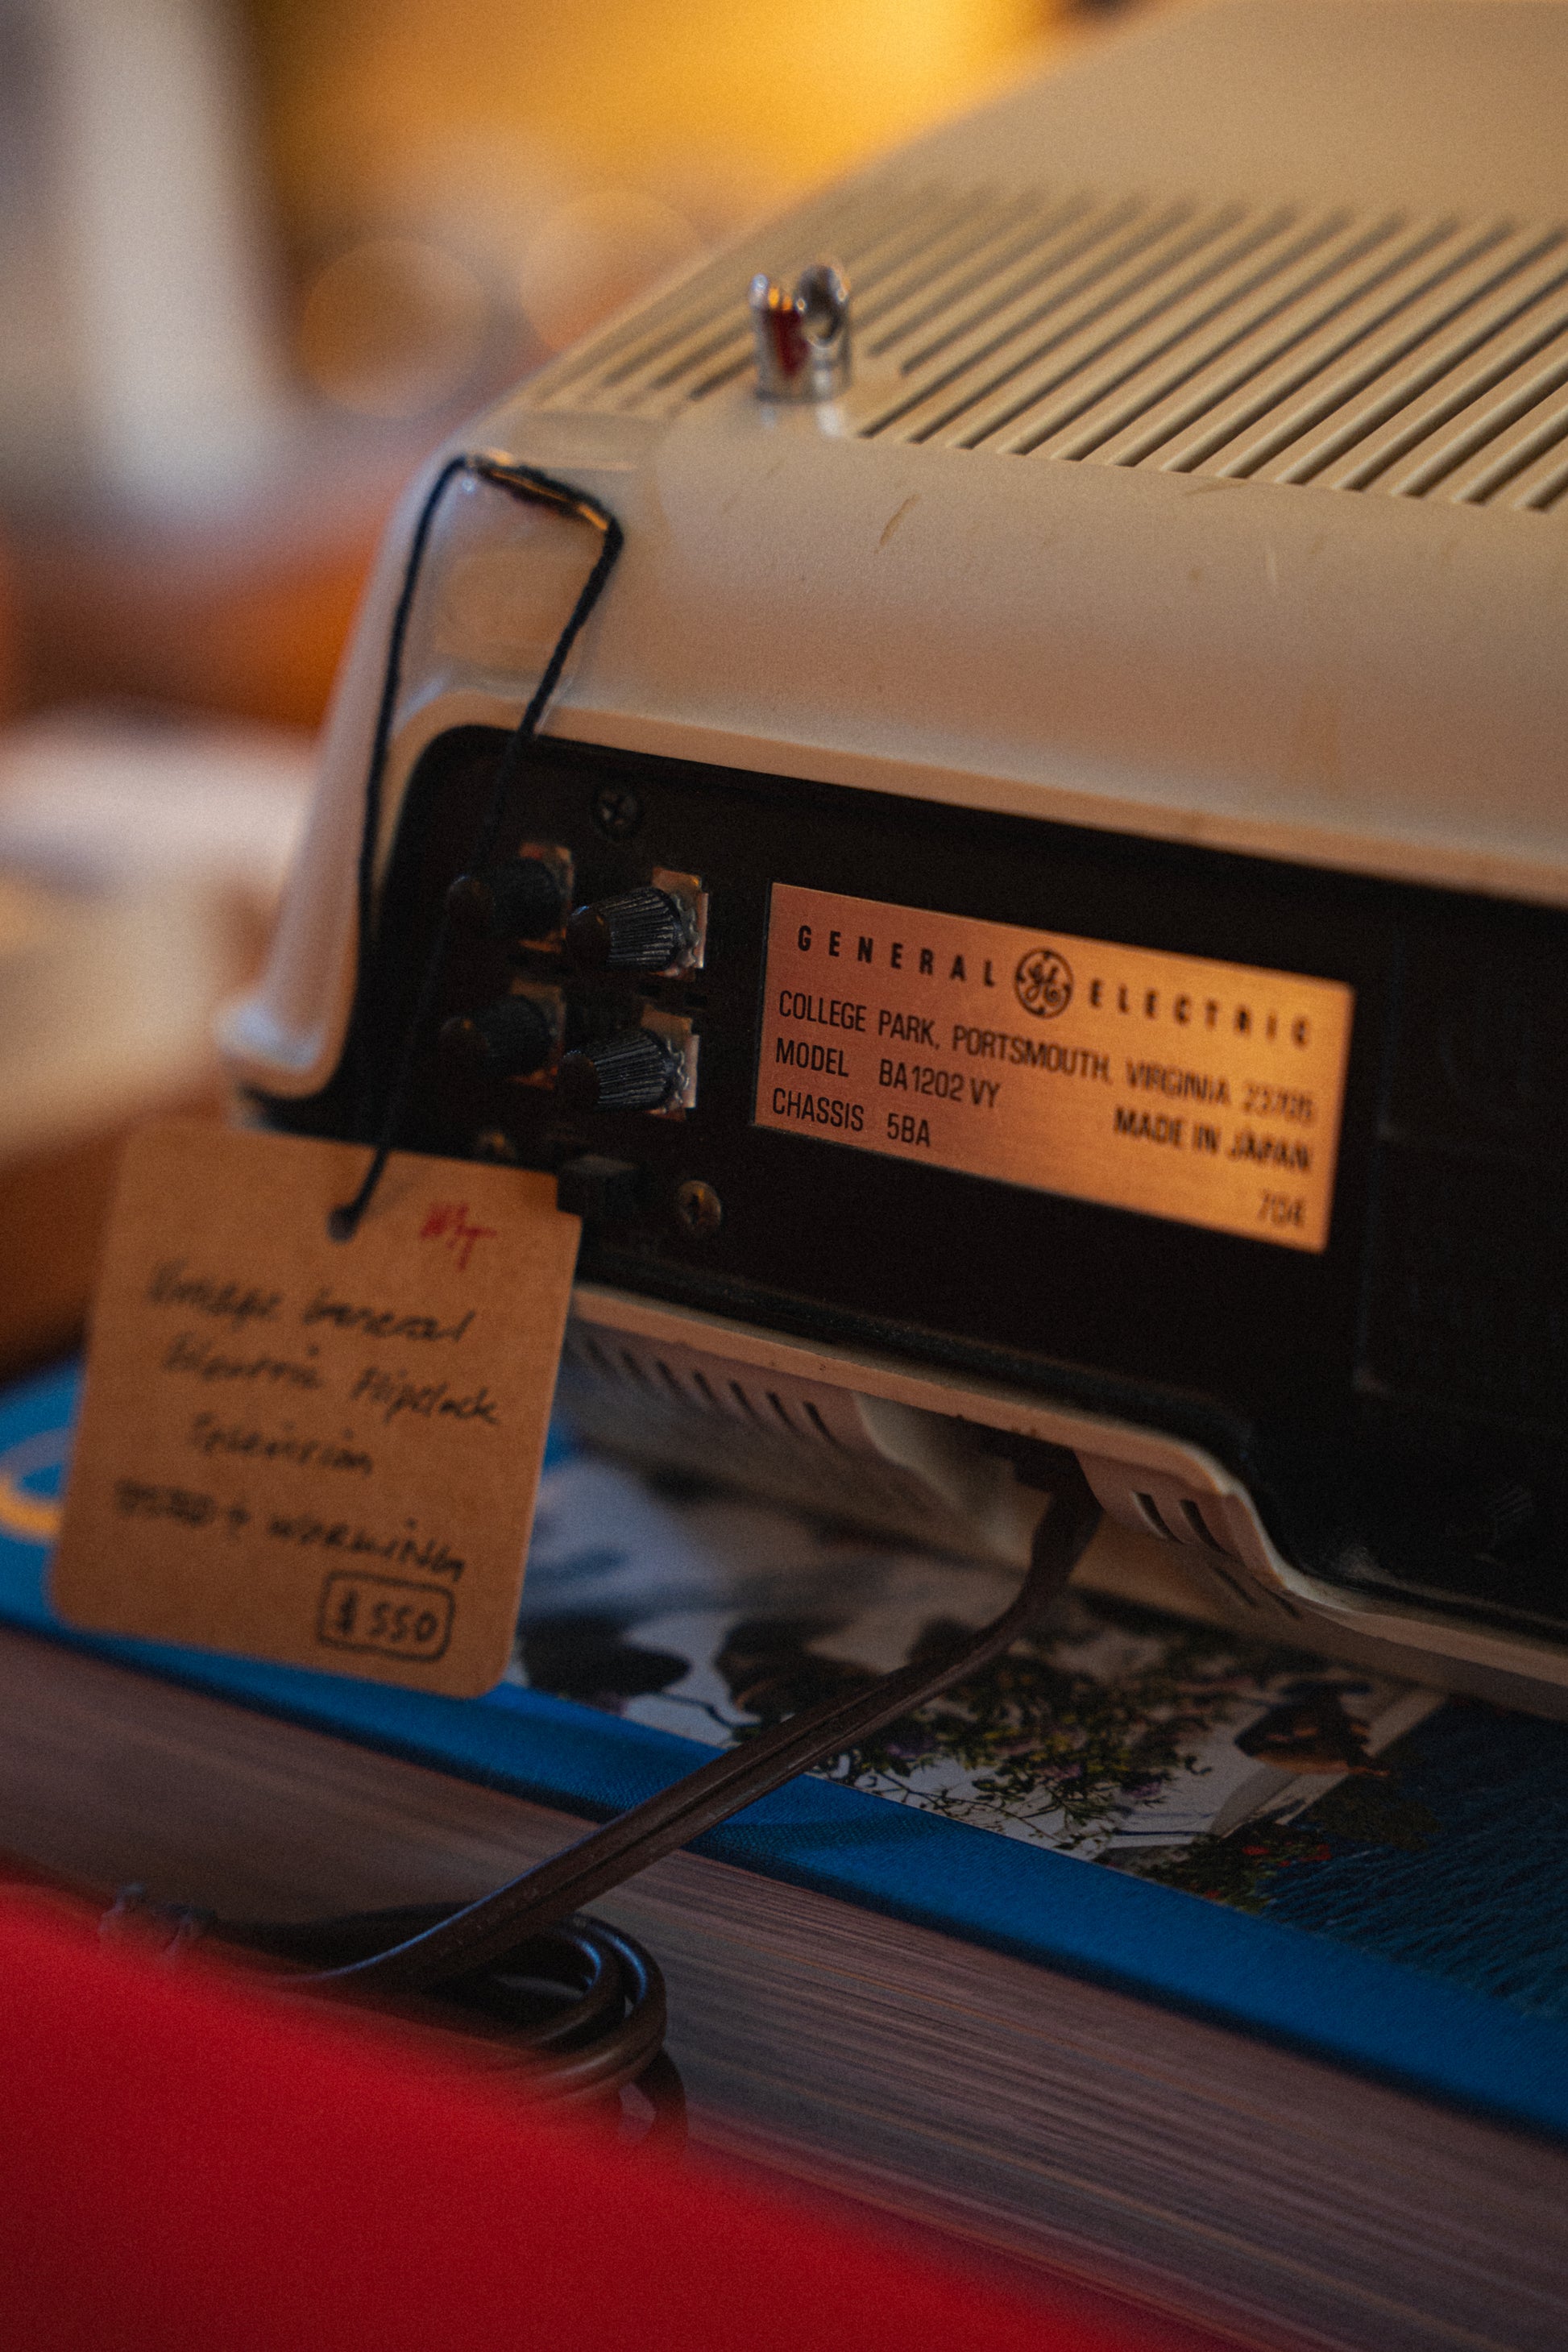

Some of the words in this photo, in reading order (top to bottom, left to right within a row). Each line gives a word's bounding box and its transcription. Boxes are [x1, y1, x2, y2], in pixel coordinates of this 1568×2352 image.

[797, 924, 997, 989] GENERAL
[1089, 977, 1312, 1047] ELECTRIC
[775, 1037, 850, 1078] MODEL
[778, 989, 866, 1033] COLLEGE
[878, 1010, 940, 1050] PARK,
[1126, 1059, 1232, 1107] VIRGINIA
[772, 1086, 865, 1133] CHASSIS
[886, 1111, 931, 1149] 5BA
[1113, 1104, 1184, 1149] MADE
[1193, 1122, 1221, 1155] IN
[1227, 1128, 1311, 1172] JAPAN
